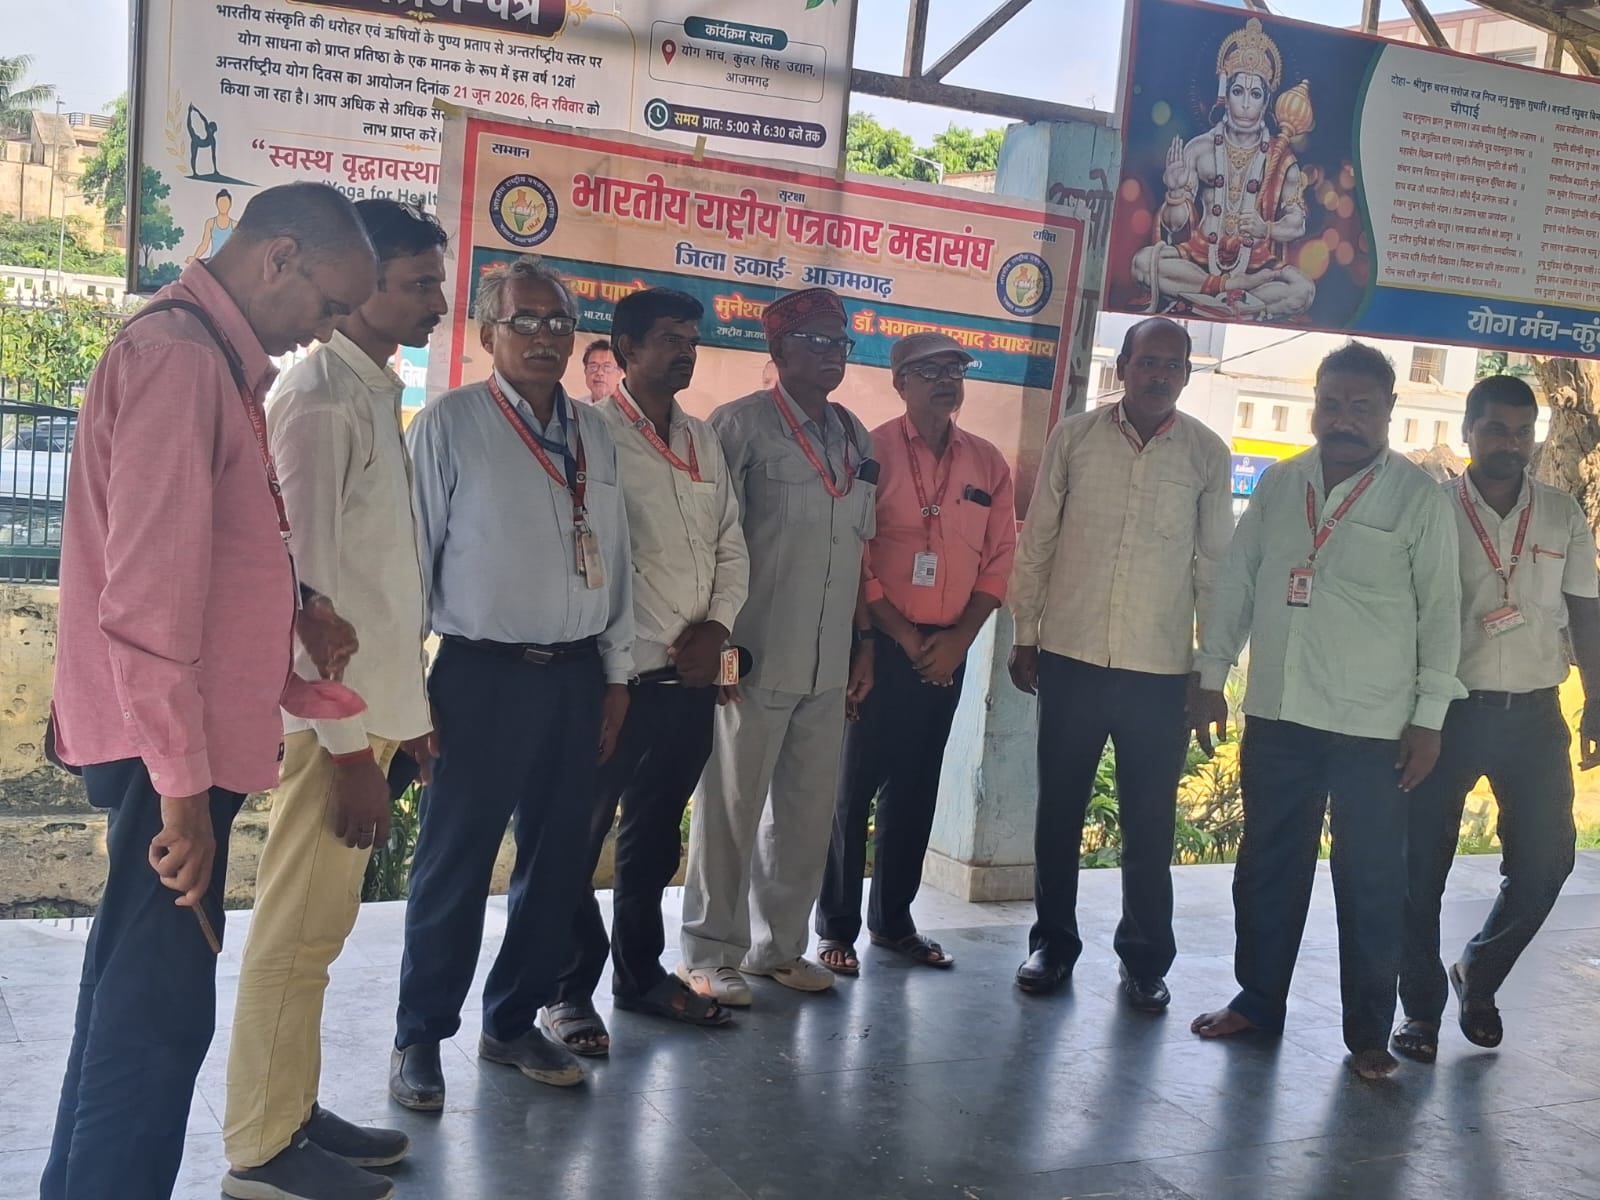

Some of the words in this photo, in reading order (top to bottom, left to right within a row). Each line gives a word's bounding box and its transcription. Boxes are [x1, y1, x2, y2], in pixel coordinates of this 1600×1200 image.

[216, 4, 261, 22] भारतीय
[265, 10, 306, 31] संस्कृति
[309, 14, 324, 31] की
[328, 17, 361, 36] धरोहर
[365, 22, 381, 38] एवं
[384, 24, 420, 43] ऋषियों
[423, 29, 435, 44] के
[438, 35, 461, 51] पुण्य
[464, 38, 491, 53] प्रताप
[494, 40, 505, 55] से
[507, 44, 564, 65] अन्तर्राष्ट्रीय
[567, 52, 587, 66] स्तर
[590, 56, 603, 69] पर
[749, 32, 773, 46] स्थल
[238, 30, 261, 47] योग
[265, 34, 301, 52] साधना
[306, 39, 321, 55] को
[325, 44, 350, 59] प्राप्त
[354, 46, 390, 64] प्रतिष्ठा
[394, 49, 406, 65] के
[408, 54, 427, 69] एक
[431, 56, 462, 73] मानक
[465, 58, 476, 74] के
[479, 64, 498, 79] रूप
[501, 64, 510, 80] में
[513, 68, 529, 83] इस
[533, 71, 548, 86] वर्ष
[552, 74, 576, 90] 12वां
[681, 42, 700, 58] योग
[733, 51, 756, 69] कुंवर
[761, 55, 780, 71] सिंह
[216, 55, 281, 76] अन्तर्राष्ट्रीय
[285, 60, 308, 78] योग
[312, 64, 343, 83] दिवस
[346, 71, 362, 85] का
[366, 73, 413, 92] आयोजन
[416, 77, 450, 96] दिनांक
[453, 86, 468, 99] 21
[472, 88, 491, 105] जून
[495, 91, 527, 109] 2026,
[530, 93, 548, 110] दिन
[552, 95, 584, 114] रविवार
[586, 99, 600, 116] को
[726, 72, 769, 91] आजमगढ़
[220, 78, 251, 97] किया
[254, 85, 270, 100] जा
[273, 88, 291, 104] रहा
[313, 93, 338, 108] आप
[341, 95, 376, 114] अधिक
[379, 98, 391, 114] से
[393, 101, 428, 119] अधिक
[1450, 101, 1480, 120] चौपाई
[363, 122, 387, 137] लाभ
[391, 125, 416, 141] प्राप्त
[674, 112, 699, 128] समय
[726, 119, 750, 134] 5:00
[752, 119, 762, 136] से
[763, 126, 786, 139] 6:30
[789, 125, 803, 141] बजे
[805, 130, 821, 143] तक
[491, 143, 530, 158] सम्मान
[342, 153, 440, 184] वृद्धावस्था
[371, 186, 393, 200] for
[778, 189, 805, 204] सुरक्षा
[571, 173, 690, 225] भारतीय
[694, 189, 783, 241] राष्ट्रीय
[785, 208, 884, 256] पत्रकार
[888, 224, 996, 272] महासंघ
[676, 242, 727, 272] जिला
[802, 265, 893, 298] आजमगढ़
[714, 294, 768, 320] मुनेश्व
[1467, 305, 1518, 337] योग
[853, 313, 874, 333] डॉ.
[988, 333, 1056, 356] उपाध्याय
